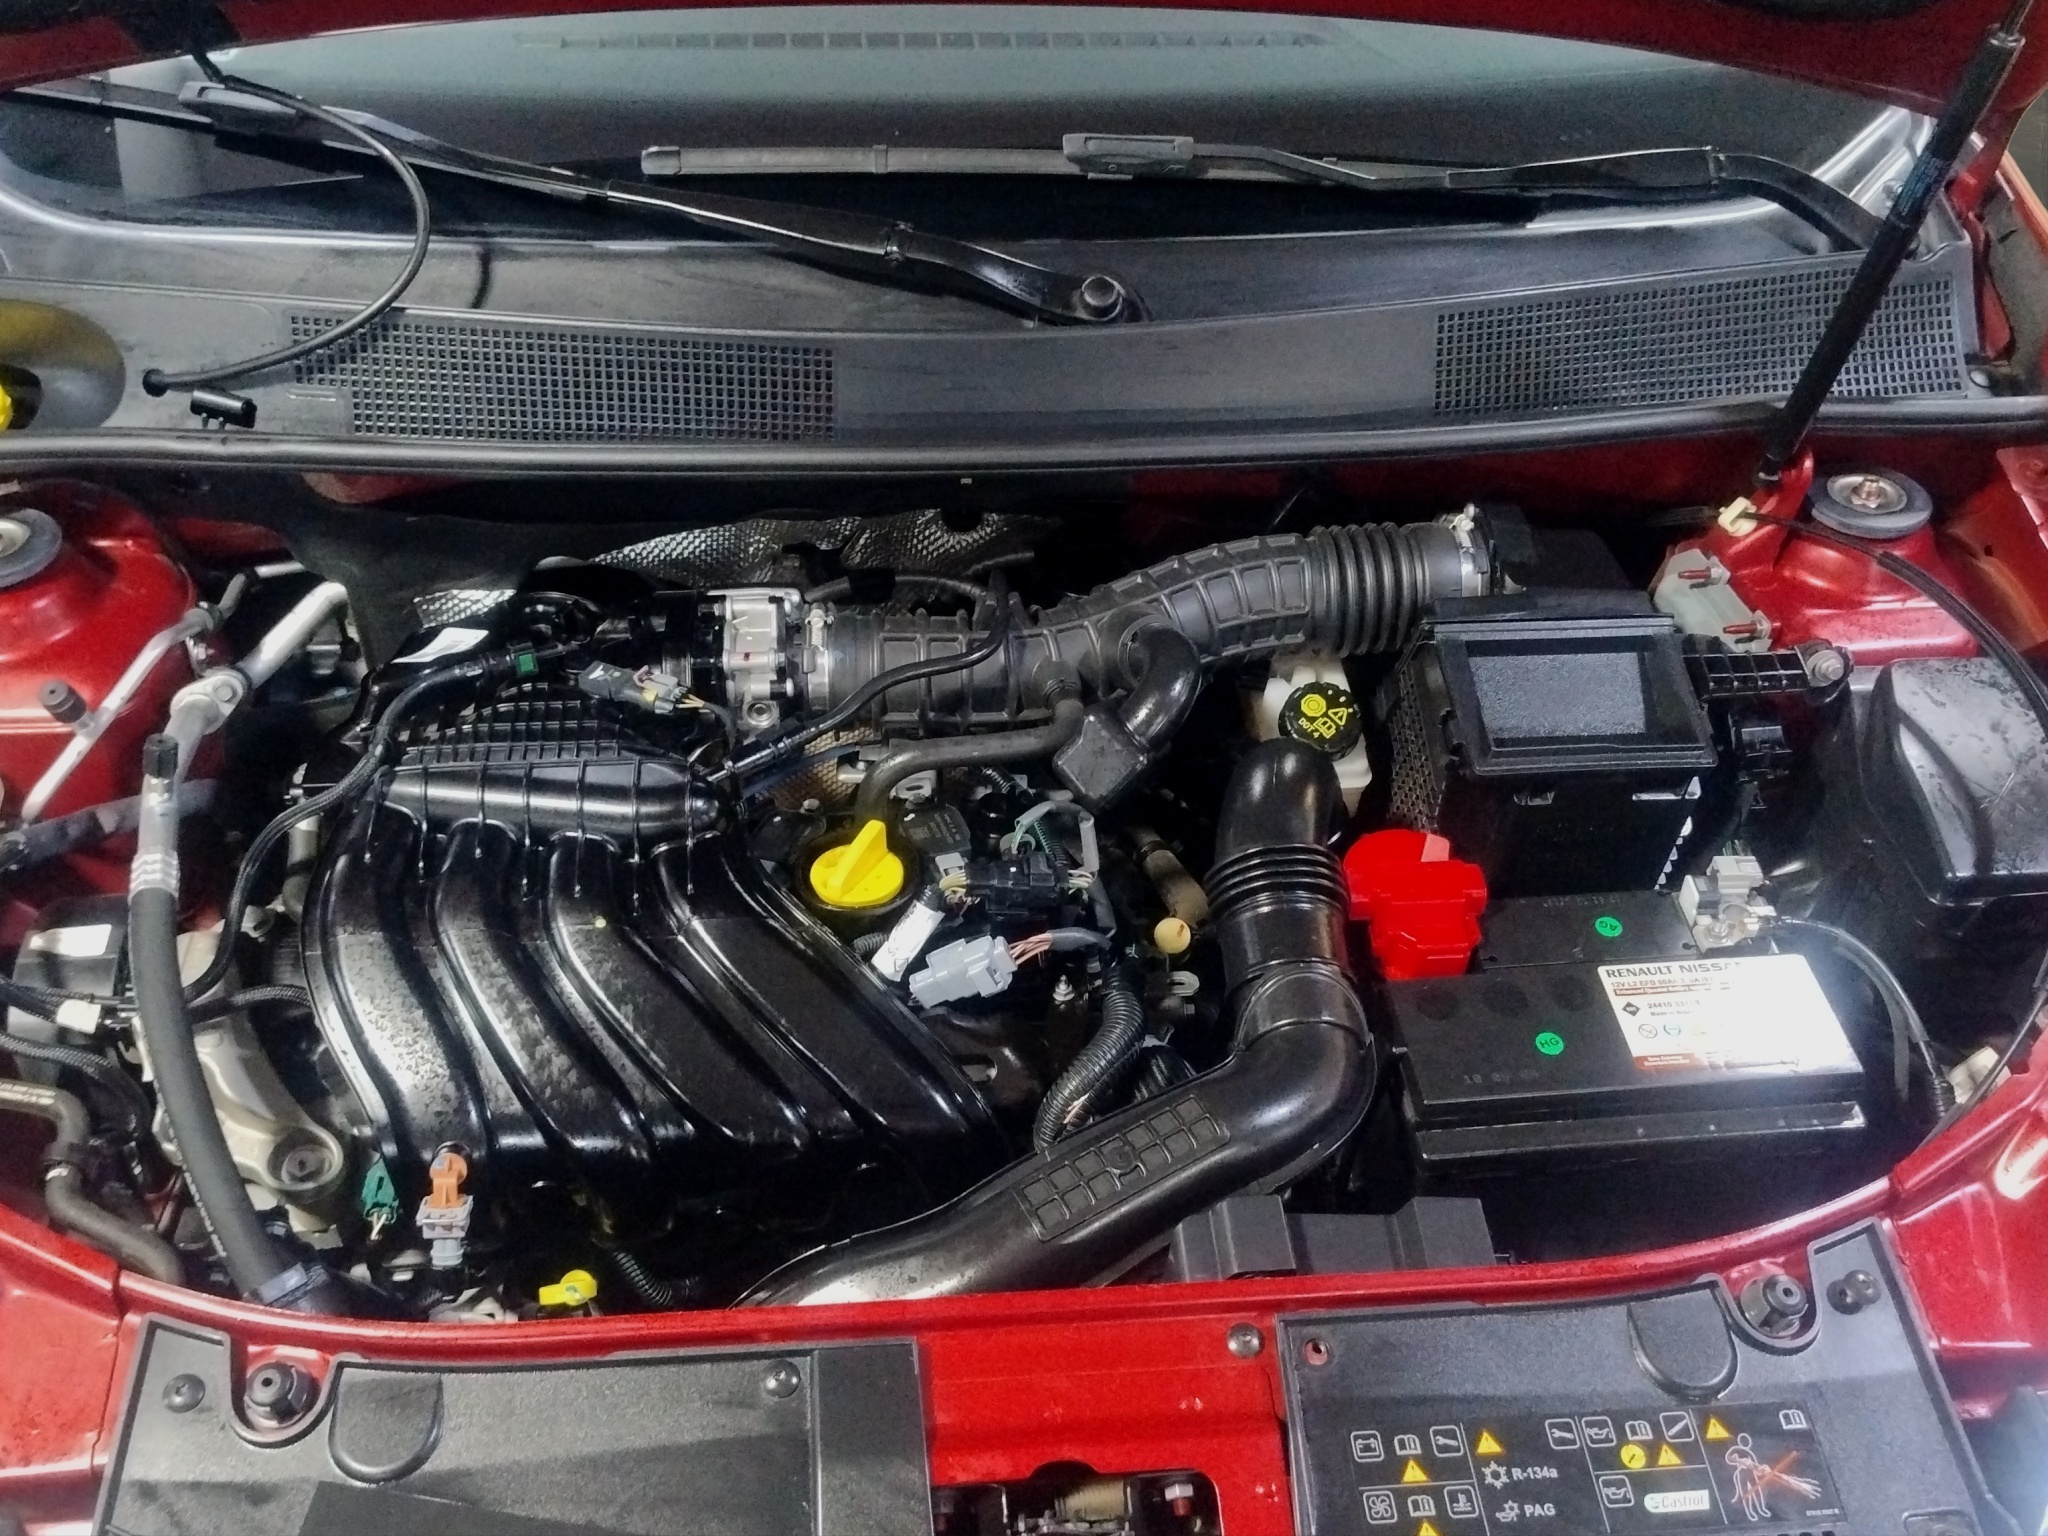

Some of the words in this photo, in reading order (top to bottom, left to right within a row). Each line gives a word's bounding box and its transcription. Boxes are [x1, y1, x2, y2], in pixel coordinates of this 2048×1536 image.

[1298, 717, 1316, 732] DOT
[1599, 920, 1619, 931] AG
[1605, 965, 1672, 977] RENAULT
[1640, 979, 1656, 987] EFB
[1647, 1001, 1672, 1009] 24410
[1539, 1037, 1559, 1048] HG
[1511, 1466, 1558, 1480] R-134a
[1662, 1495, 1705, 1508] Castrol
[1524, 1503, 1556, 1517] PAG
